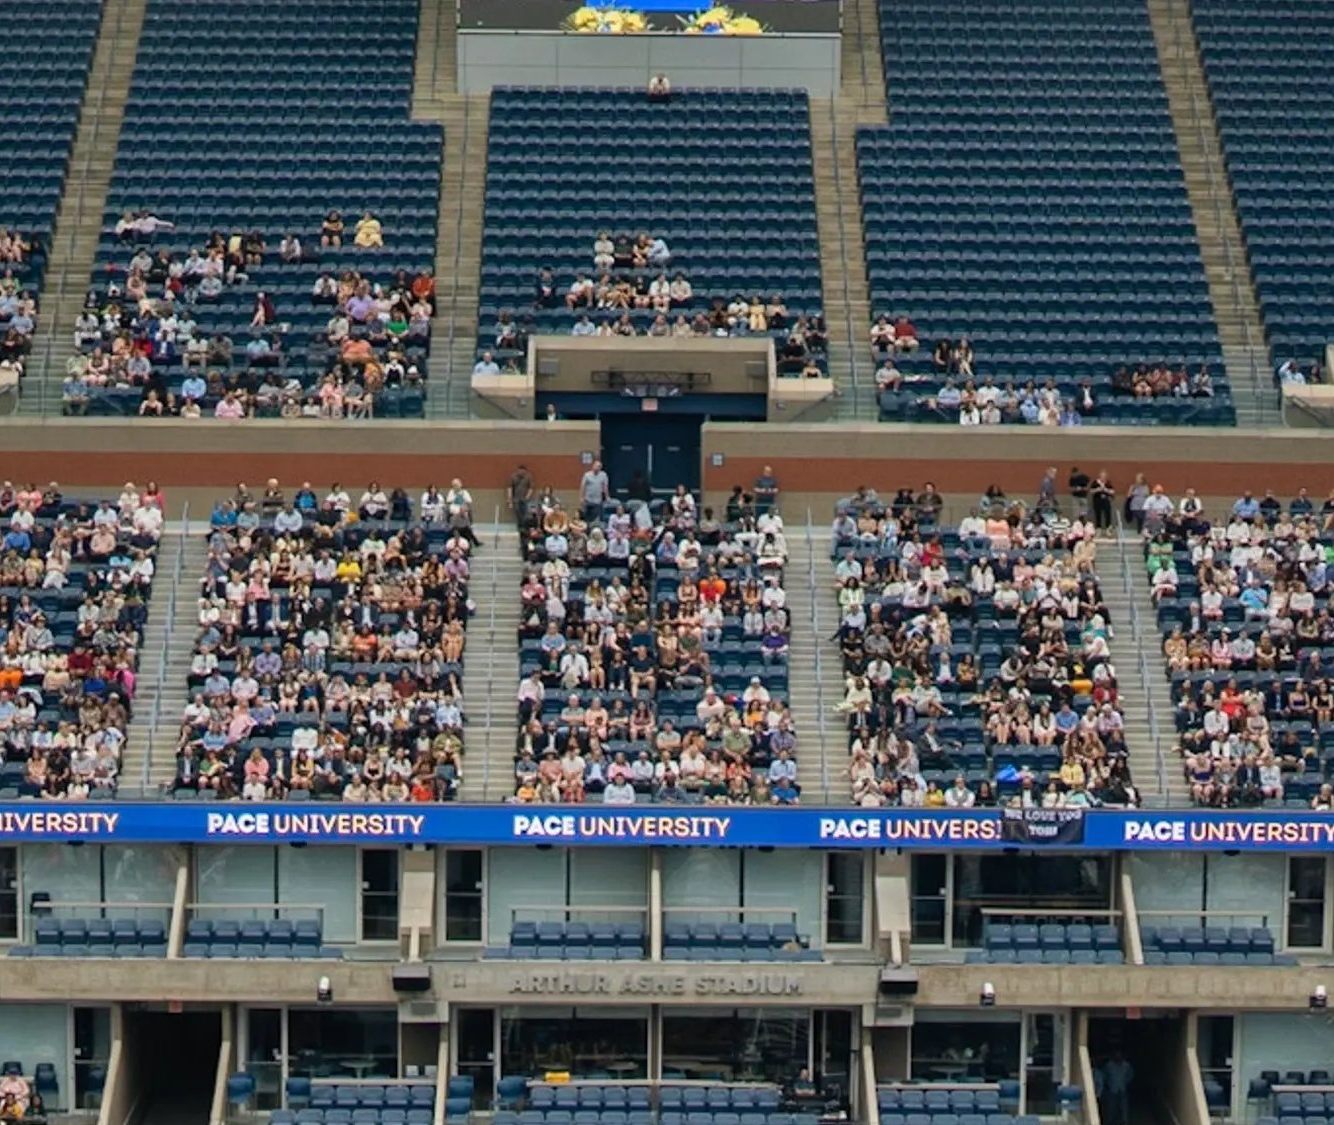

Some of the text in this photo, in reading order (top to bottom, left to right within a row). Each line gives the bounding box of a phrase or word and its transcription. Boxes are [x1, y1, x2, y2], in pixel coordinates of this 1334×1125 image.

[207, 813, 425, 836] PACE UNIVERSITY
[513, 815, 731, 838] PACE UNIVERSITY
[1025, 810, 1056, 822] LOVE
[820, 818, 1003, 840] PACE UNIVERSI
[1124, 821, 1186, 842] PACE
[509, 971, 803, 996] ARTHUR ASHE STADIUM
